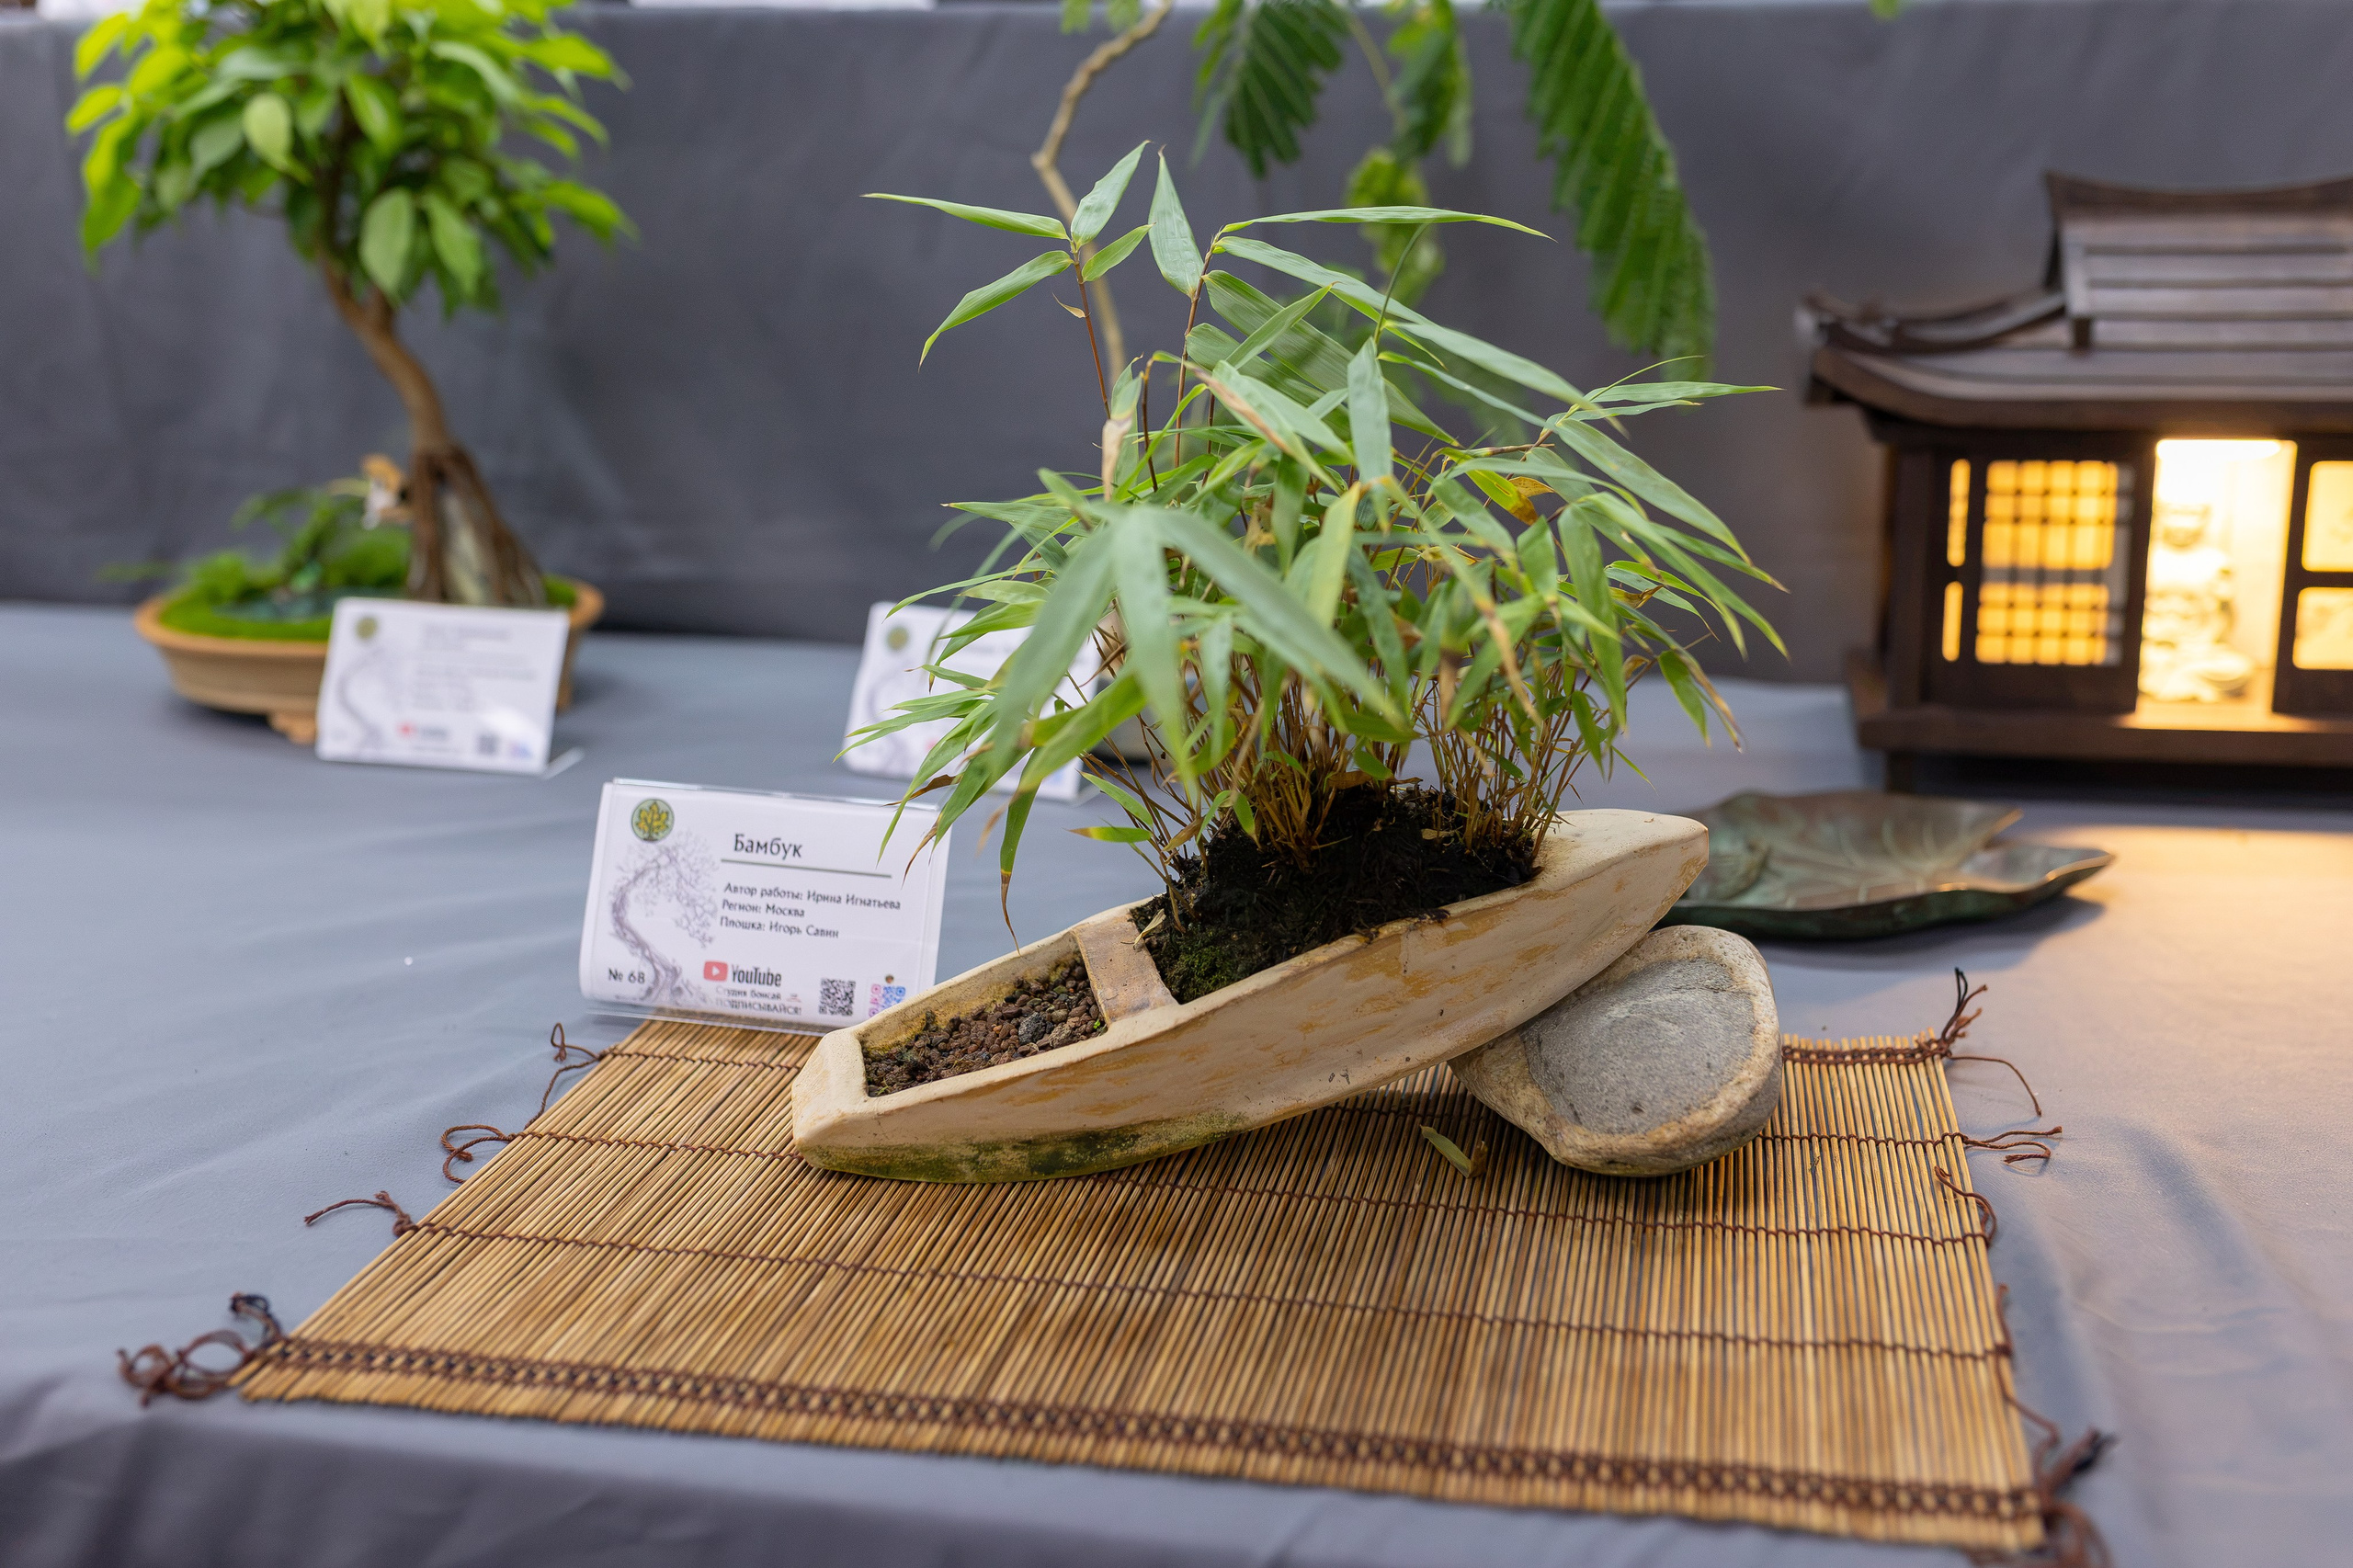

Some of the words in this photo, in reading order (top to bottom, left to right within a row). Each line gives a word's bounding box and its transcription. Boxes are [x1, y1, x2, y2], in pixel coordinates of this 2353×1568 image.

[733, 834, 802, 860] Бамбук
[724, 882, 757, 897] Автор
[760, 887, 803, 901] работы:
[807, 891, 842, 904] Ирина
[846, 894, 901, 910] Игнатьева
[722, 899, 762, 914] Регион:
[766, 903, 805, 918] Москва
[720, 916, 766, 931] Плошка:
[769, 921, 802, 936] Игорь
[806, 925, 839, 938] Савин
[627, 971, 645, 983] 68
[732, 964, 782, 987] YouTube
